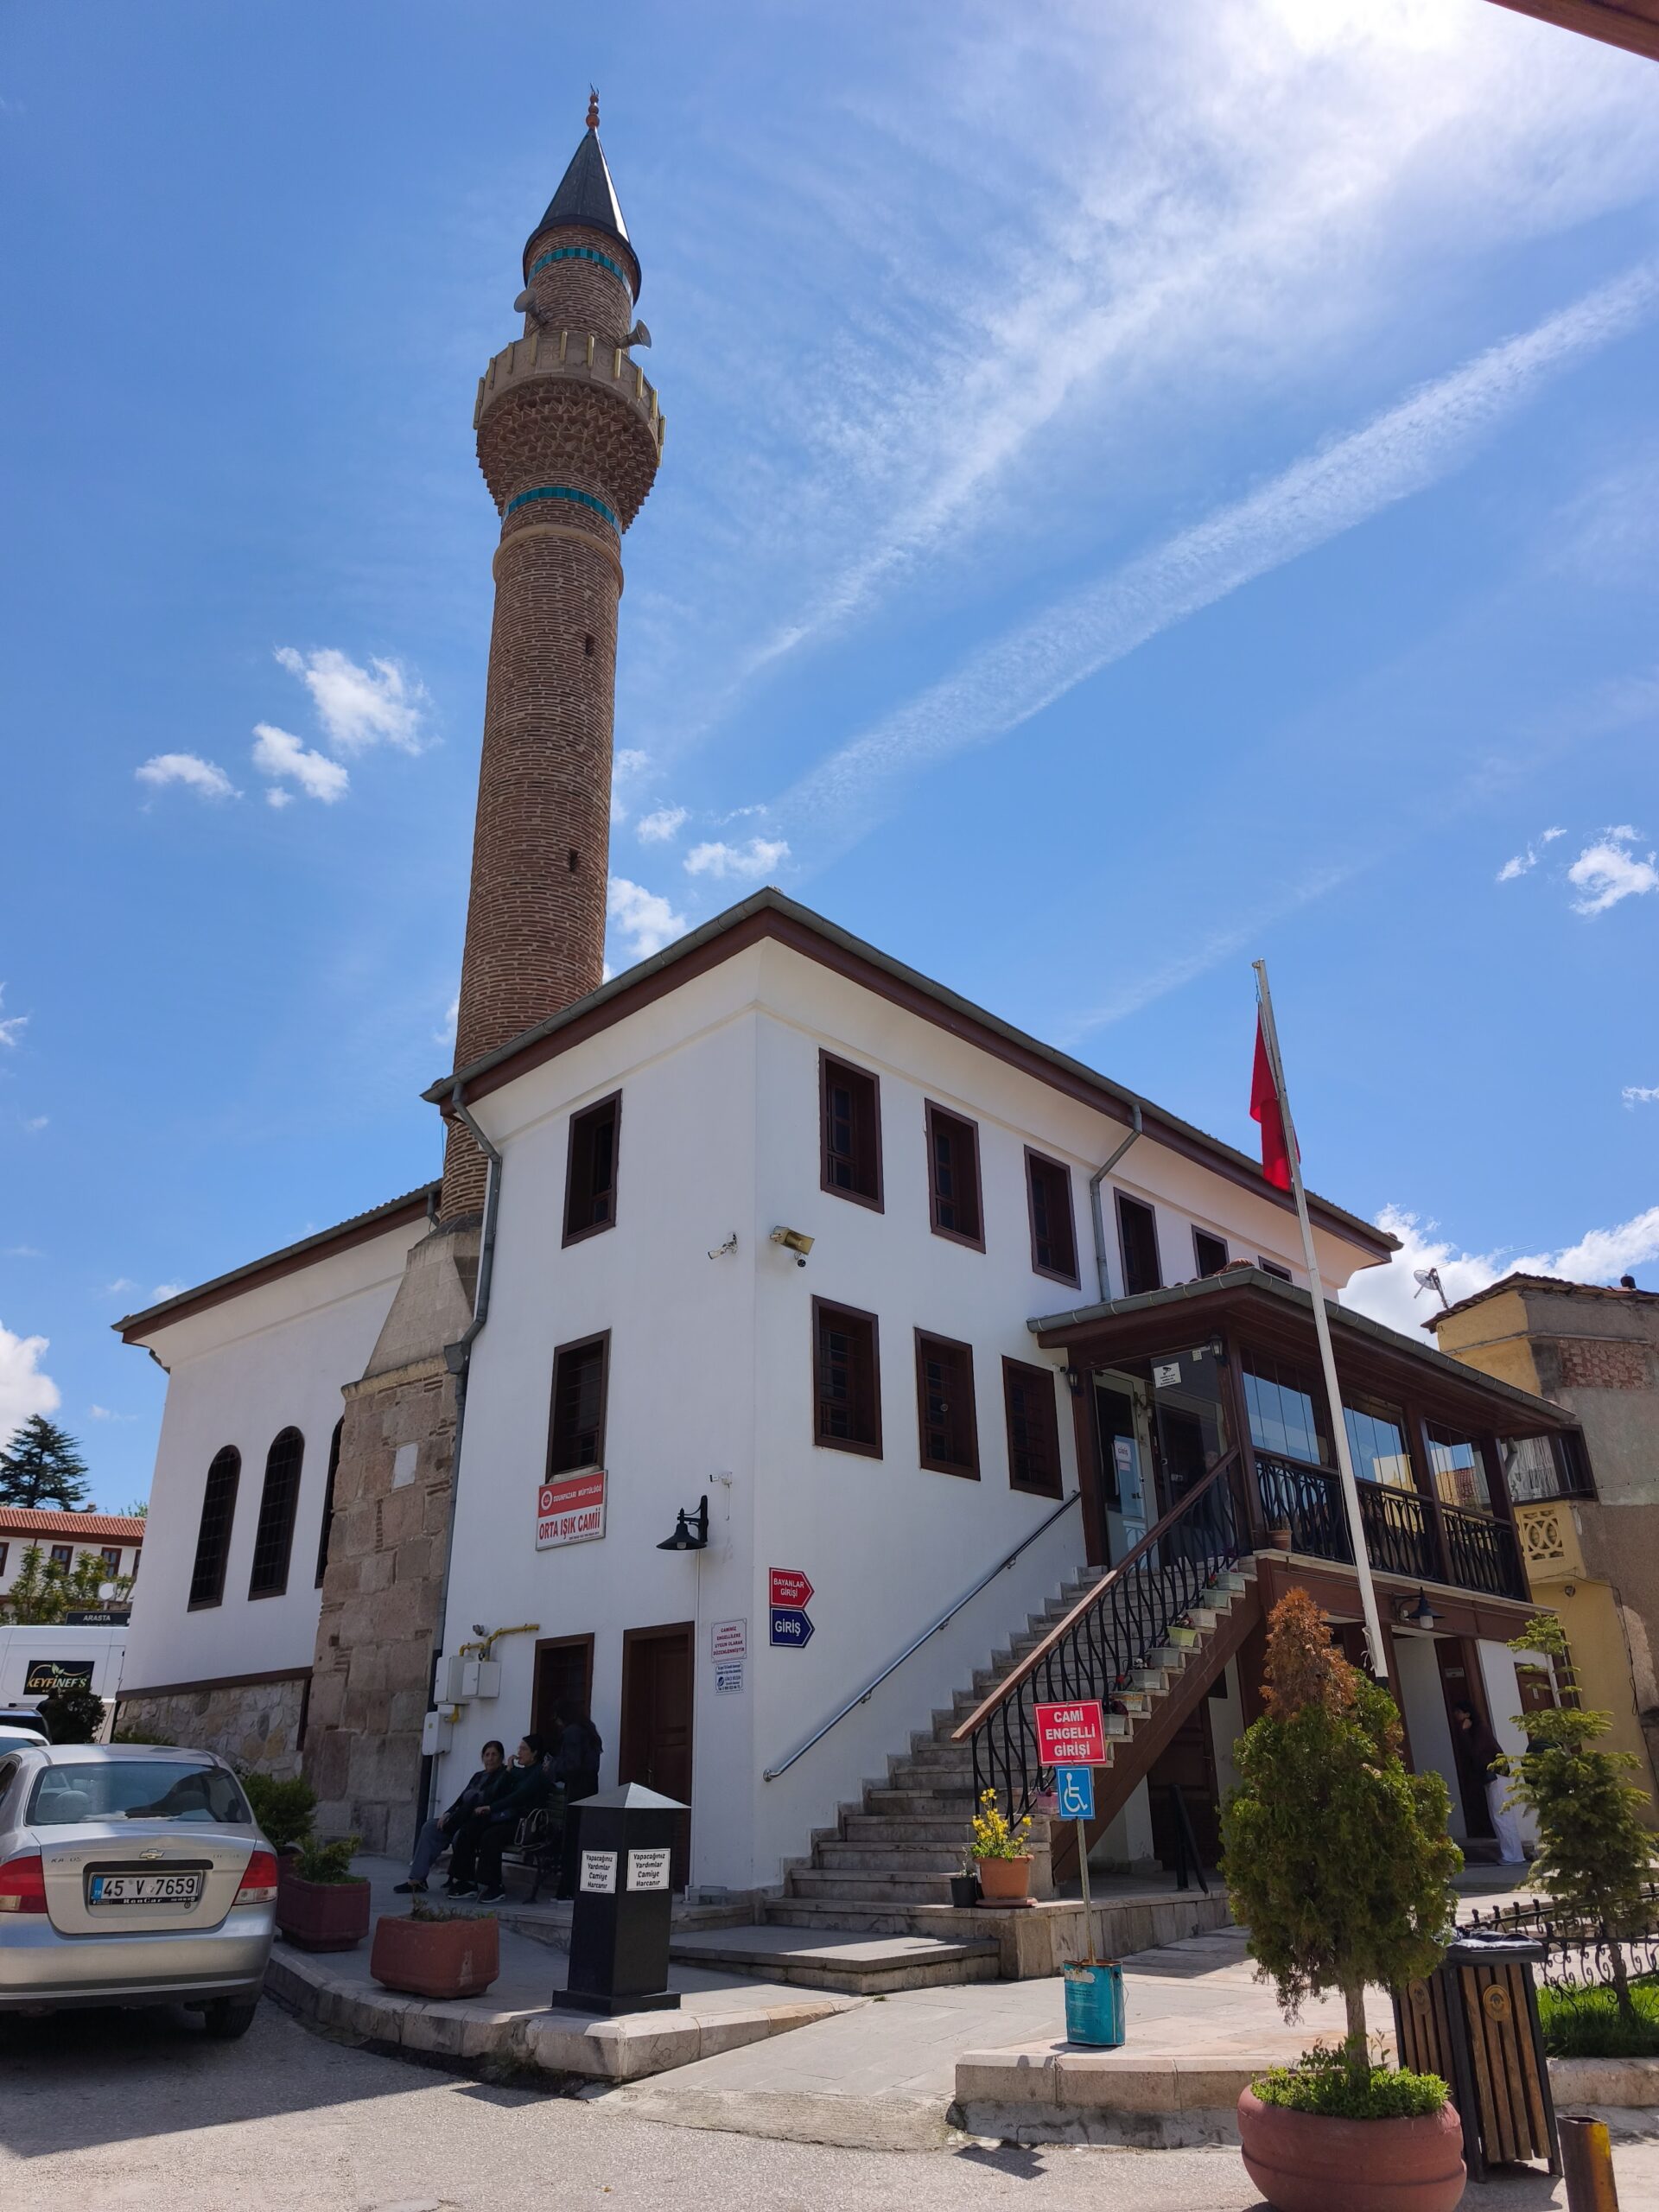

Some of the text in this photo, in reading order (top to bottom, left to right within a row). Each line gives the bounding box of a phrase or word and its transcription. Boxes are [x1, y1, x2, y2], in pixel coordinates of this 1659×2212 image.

[539, 1507, 601, 1540] ORTA IŞIK CAMİİ
[773, 1578, 804, 1589] BAYANLAR
[780, 1586, 798, 1599] GİRİŞİ
[774, 1618, 801, 1637] GİRİŞ
[1054, 1707, 1084, 1723] CAMİ
[1045, 1723, 1096, 1740] ENGELLİ
[1054, 1741, 1090, 1758] GİRİŞİ
[586, 1854, 613, 1863] Yapacağınız
[588, 1872, 607, 1881] Camiye
[638, 1870, 660, 1878] Camiye
[104, 1878, 195, 1897] 45 V 7659
